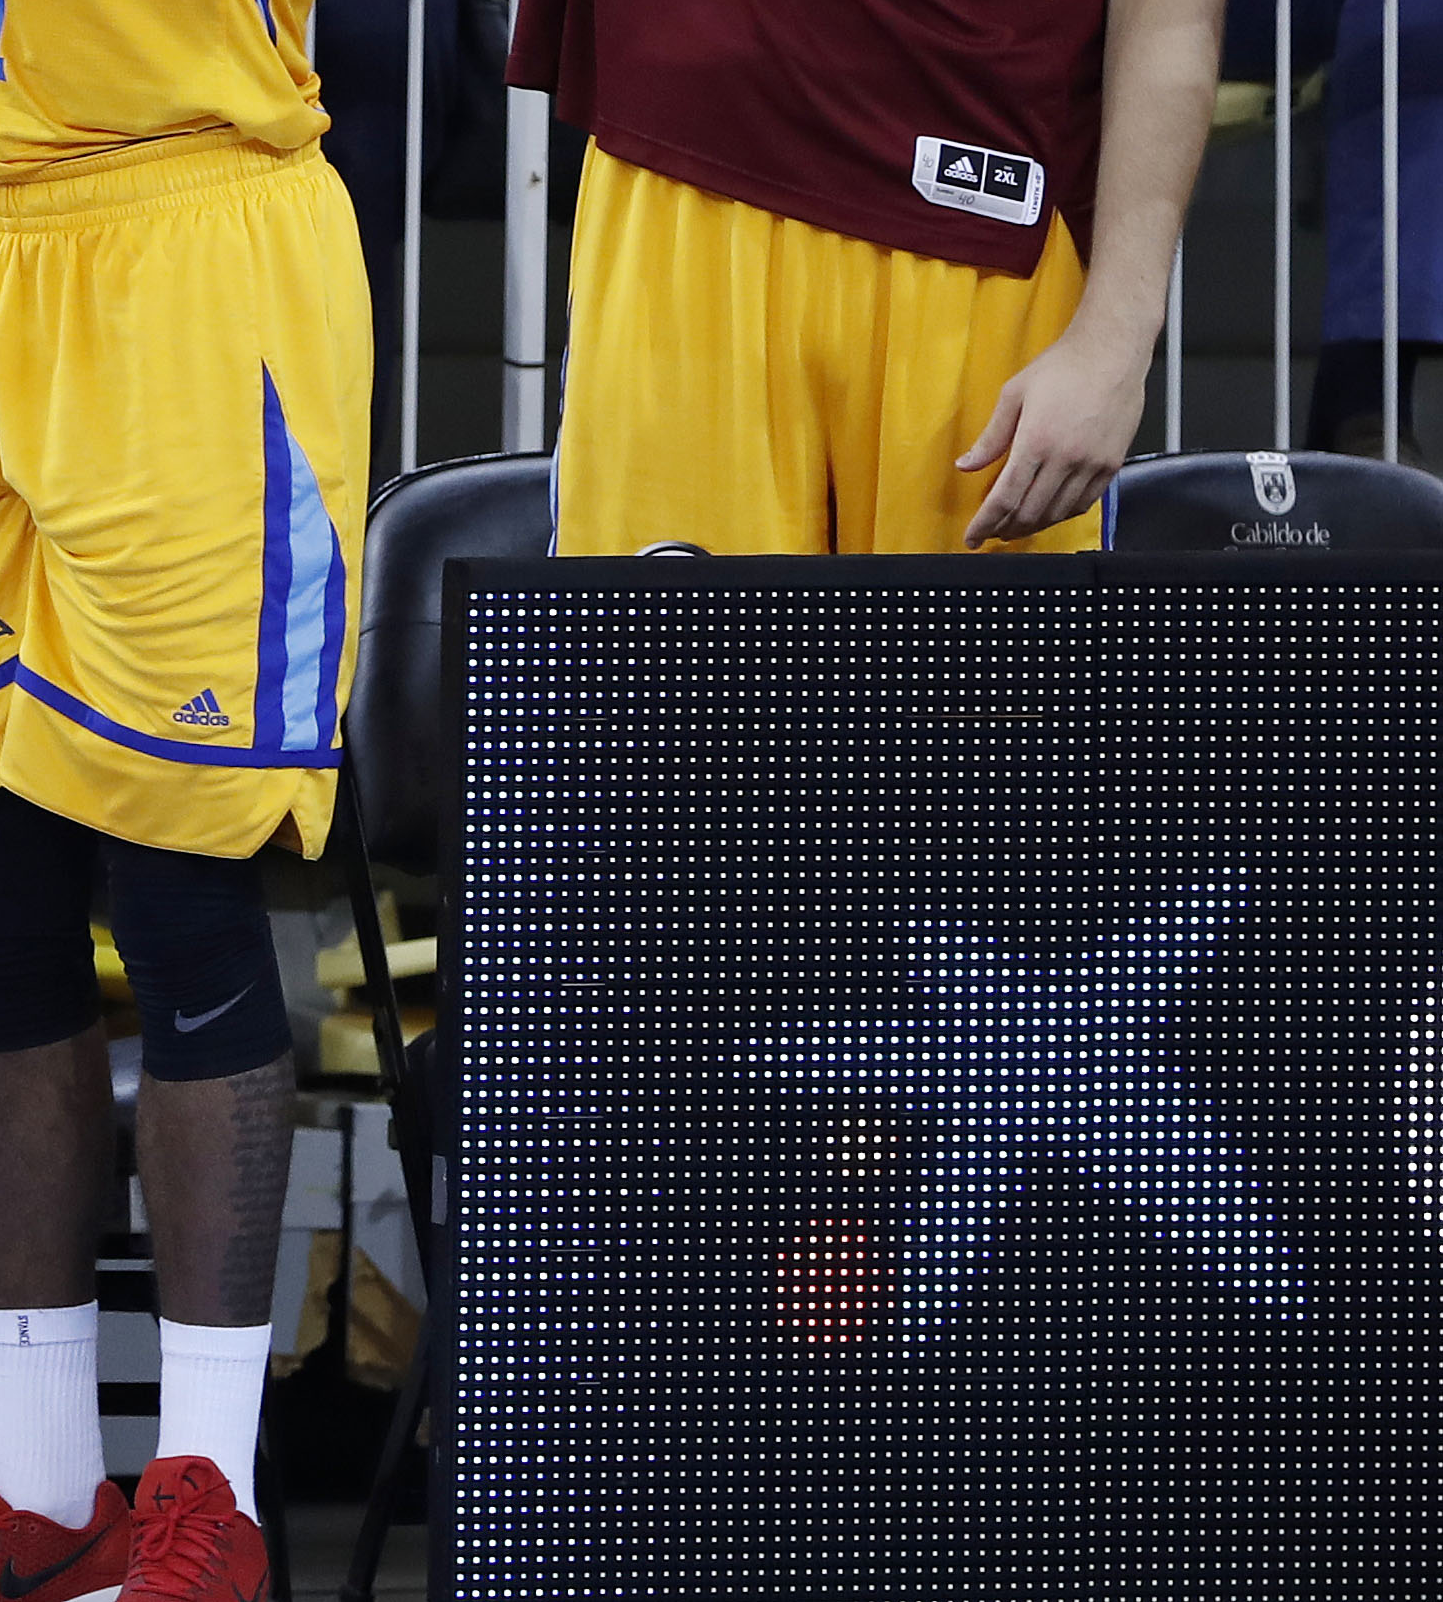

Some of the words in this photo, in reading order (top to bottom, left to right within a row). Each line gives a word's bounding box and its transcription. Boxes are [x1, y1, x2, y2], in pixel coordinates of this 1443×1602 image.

[943, 167, 979, 184] adidas
[994, 169, 1019, 186] 2XL
[1231, 521, 1303, 546] Cabildo
[1305, 521, 1331, 546] de
[172, 710, 230, 727] adidas
